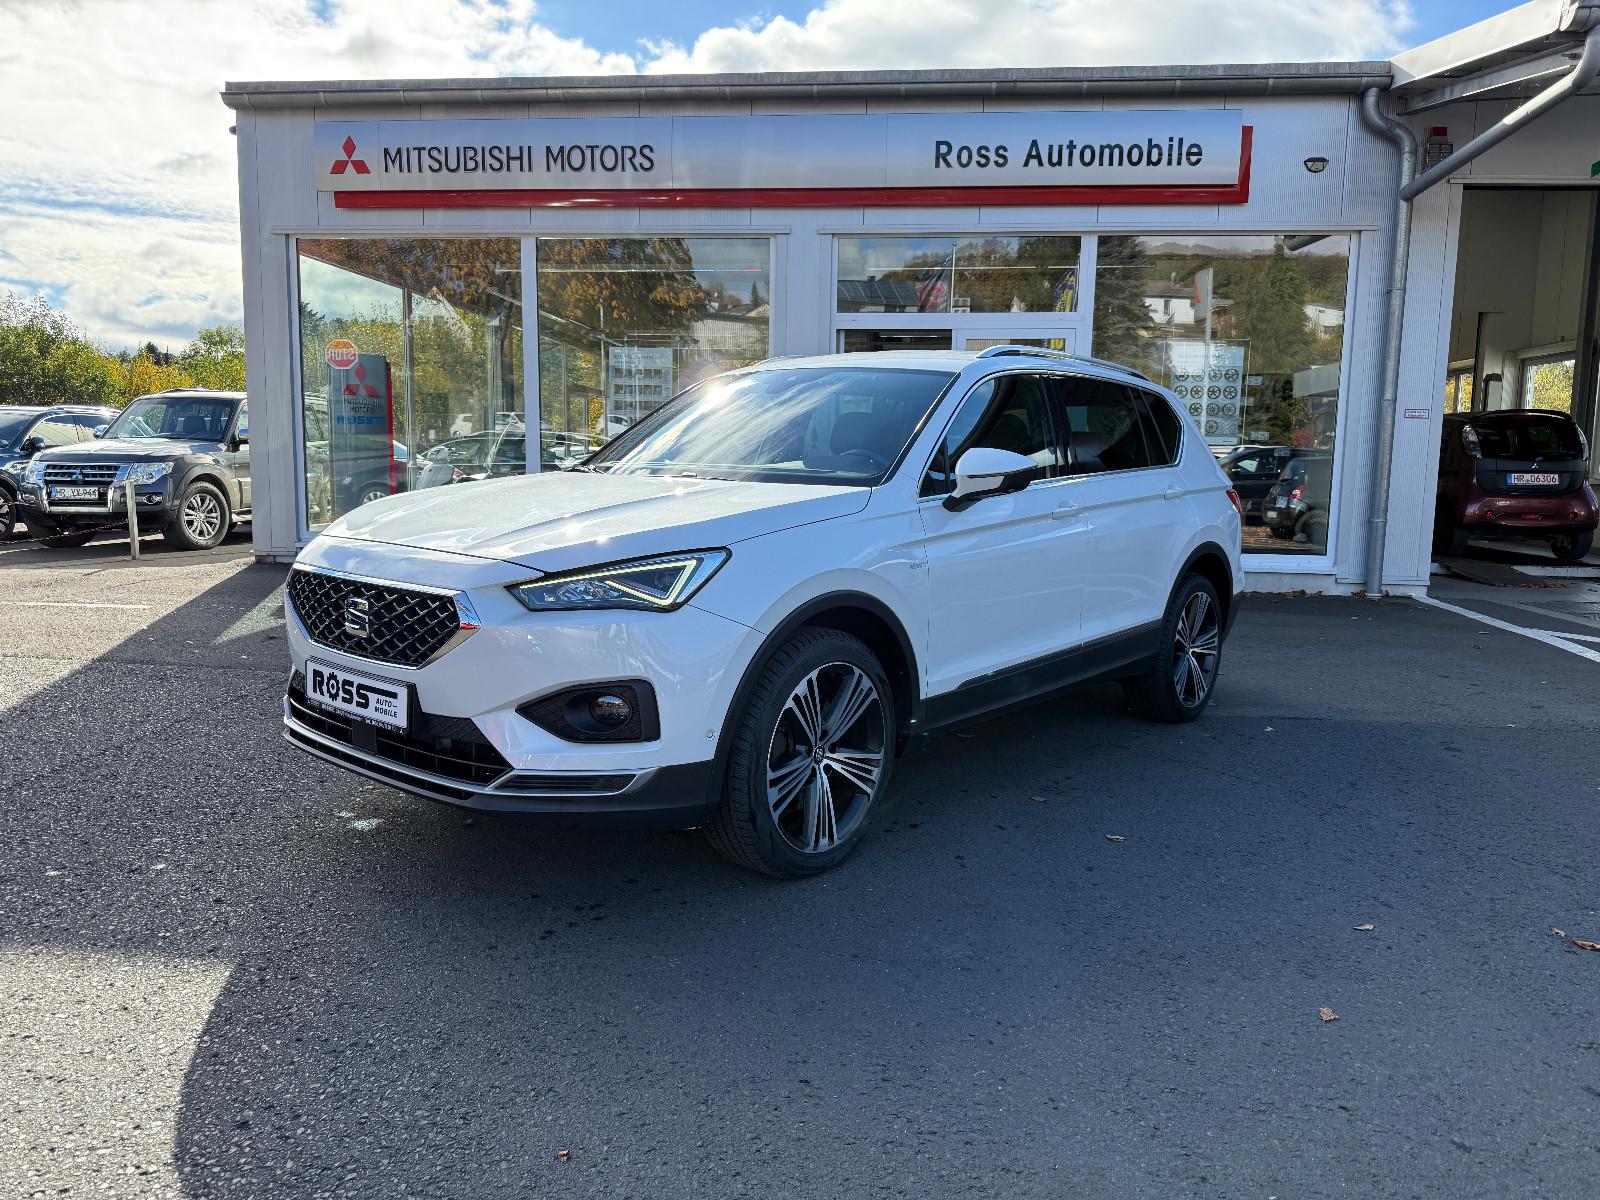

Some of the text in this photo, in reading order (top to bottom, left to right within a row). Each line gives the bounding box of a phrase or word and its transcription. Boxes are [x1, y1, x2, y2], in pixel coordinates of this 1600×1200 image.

[383, 144, 655, 173] MITSUBISHI MOTORS
[934, 136, 1203, 169] Ross Automobile
[1513, 474, 1557, 483] HR 06306
[312, 668, 398, 710] ROSS
[374, 706, 398, 719] MOBILE
